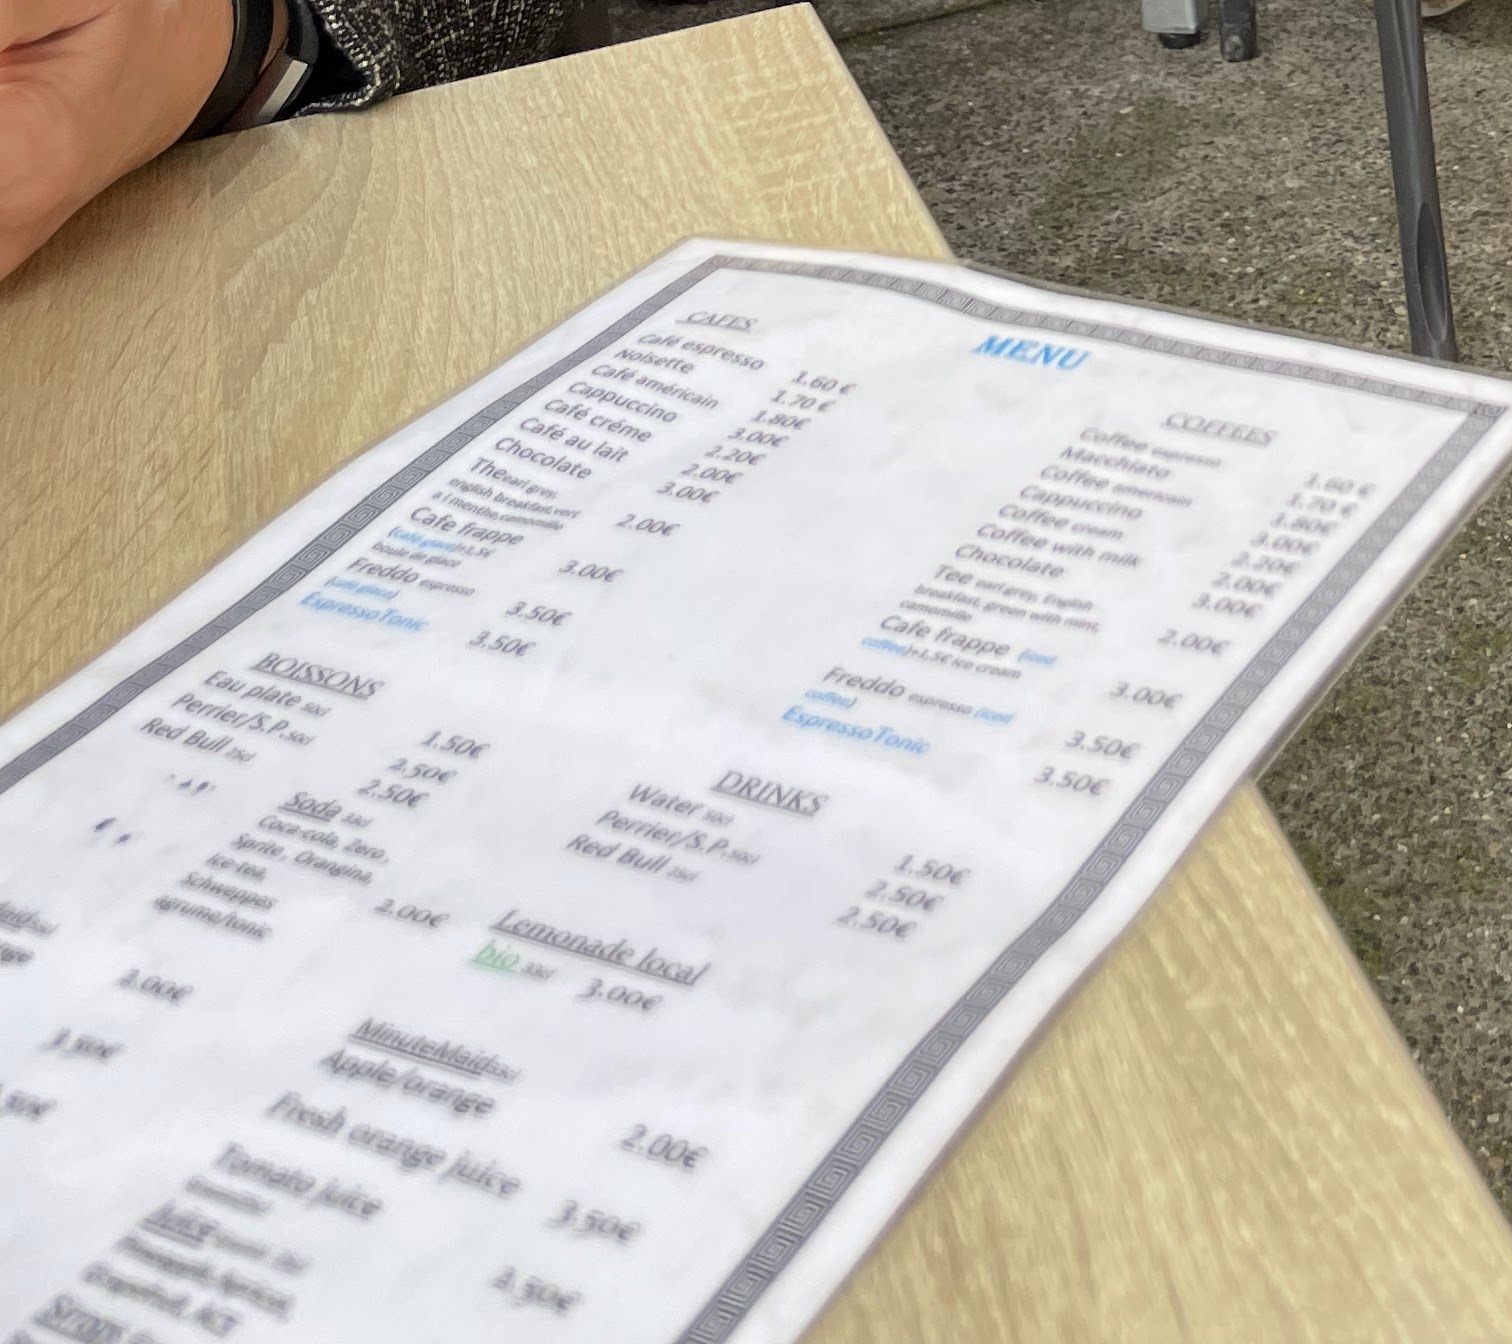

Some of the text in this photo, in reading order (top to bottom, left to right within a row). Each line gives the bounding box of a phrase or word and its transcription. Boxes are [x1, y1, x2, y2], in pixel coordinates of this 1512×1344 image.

[613, 348, 695, 374] Noisette
[637, 333, 765, 371] Café espresso
[972, 334, 1092, 371] MENU
[567, 381, 678, 423] Cappuccino
[591, 364, 719, 409] Café américain
[544, 398, 589, 420] Café
[520, 417, 630, 463] Café au lait
[727, 427, 790, 448] 3.00€
[1079, 426, 1149, 452] Coffee
[494, 437, 592, 480] Chocolate
[704, 445, 767, 466] 2.20€
[1058, 444, 1171, 480] Macchiato
[681, 463, 744, 484] 2.00€
[1039, 464, 1111, 490] Coffee
[656, 481, 720, 503] 3.00€
[1019, 483, 1143, 520] Cappuccino
[616, 513, 681, 537] 2.00€
[998, 503, 1069, 529] Coffee
[954, 543, 1065, 579] Chocolate
[976, 522, 1141, 569] Coffee with milk
[346, 557, 420, 584] Freddo
[558, 560, 624, 583] 3.00€
[933, 563, 974, 585] Tee
[1211, 571, 1283, 597] 2.00€
[505, 600, 573, 626] 3.50€
[1191, 592, 1264, 619] 3.00€
[469, 630, 537, 657] 3.50€
[934, 626, 1012, 658] frappe
[1157, 627, 1231, 655] 2.00€
[202, 670, 248, 693] Eau
[239, 683, 303, 708] plate
[250, 651, 385, 700] BOISSONS
[822, 665, 907, 699] Freddo
[1108, 680, 1184, 710] 3.00€
[140, 716, 191, 740] Red
[183, 728, 234, 753] Bull
[420, 729, 492, 759] 1.50€
[1064, 729, 1142, 760] 3.50€
[356, 778, 431, 808] 2.50€
[709, 769, 829, 817] DRINKS
[1033, 766, 1111, 797] 3.50€
[278, 791, 343, 822] Soda
[627, 783, 703, 815] Water
[566, 832, 622, 859] Red
[616, 846, 673, 873] Bull
[893, 853, 972, 887] 1.50€
[864, 879, 945, 913] 2.50€
[835, 905, 918, 939] 2.50€
[469, 938, 522, 974] bio
[491, 908, 713, 986] Lemonade local
[619, 1123, 709, 1169] 2.00€
